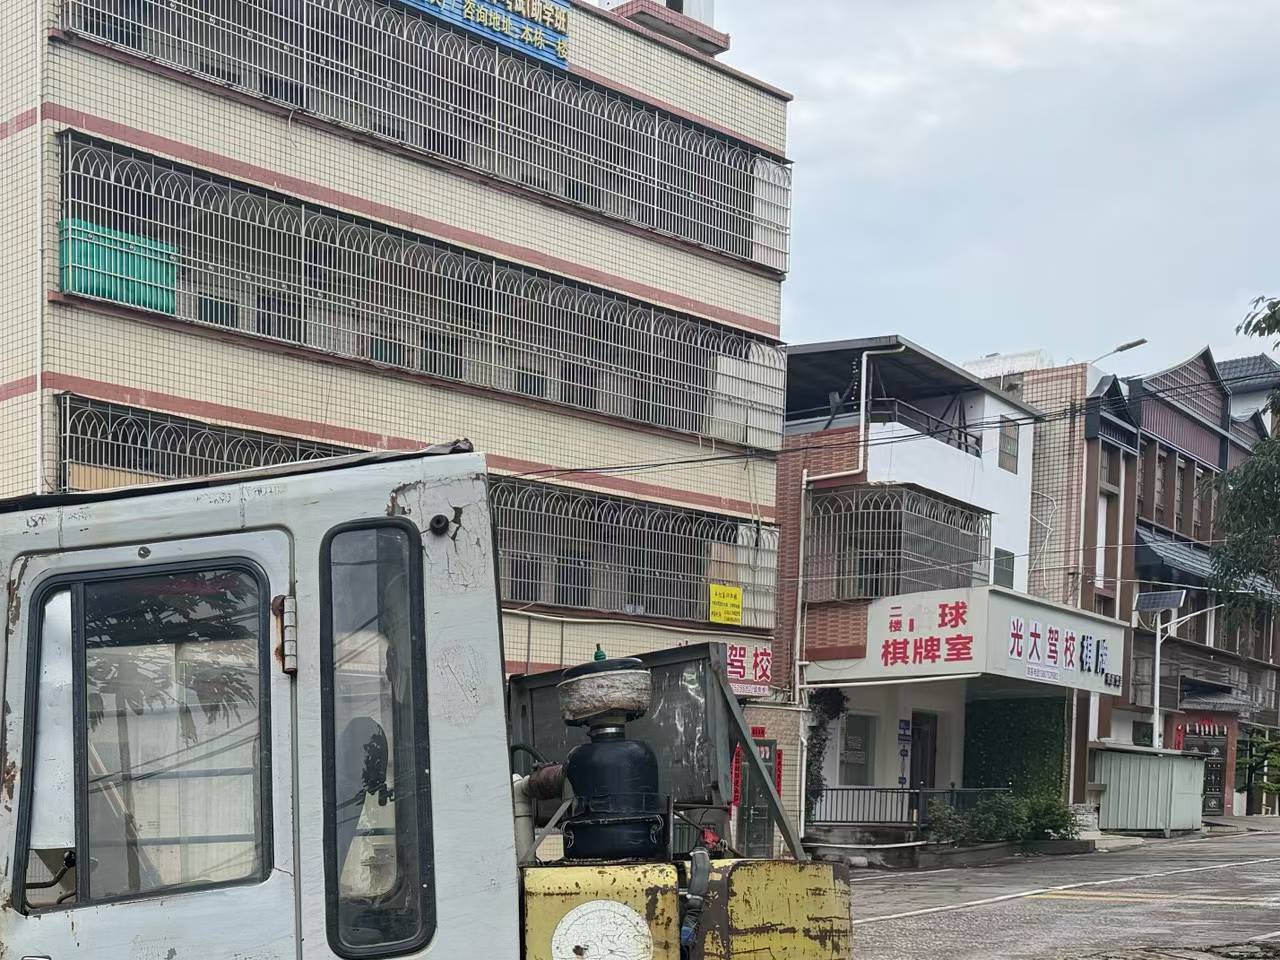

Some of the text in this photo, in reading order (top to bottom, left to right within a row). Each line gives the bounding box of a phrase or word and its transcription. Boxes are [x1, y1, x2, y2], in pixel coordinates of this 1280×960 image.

[937, 601, 967, 628] 球
[881, 633, 973, 667] 棋牌室
[1010, 618, 1075, 668] 光大驾校
[728, 645, 771, 682] 驾校
